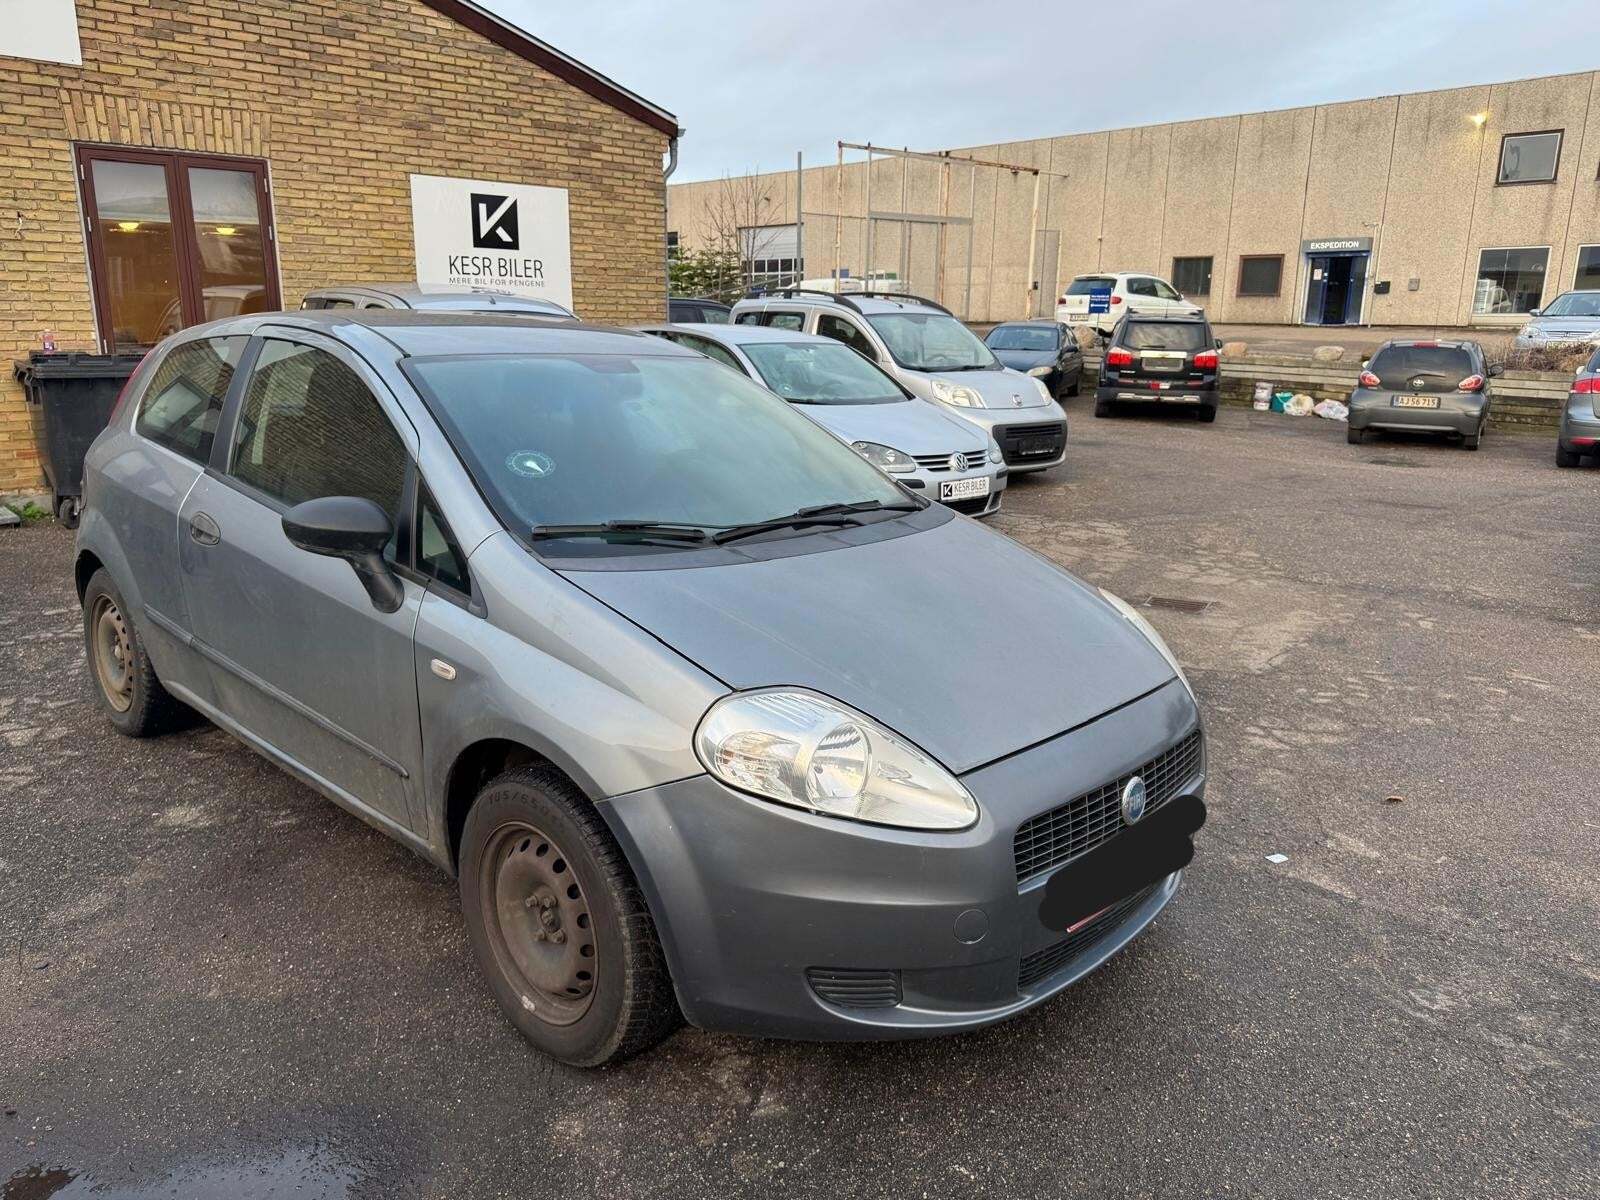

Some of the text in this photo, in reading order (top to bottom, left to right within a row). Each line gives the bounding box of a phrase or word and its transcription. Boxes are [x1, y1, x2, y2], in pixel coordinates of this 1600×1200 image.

[479, 193, 517, 243] K
[1310, 241, 1359, 249] EKSPEDITION
[449, 255, 544, 279] KESR BILER
[449, 277, 472, 285] MERE
[510, 279, 545, 287] PENGENE
[954, 479, 986, 492] KESR BILER
